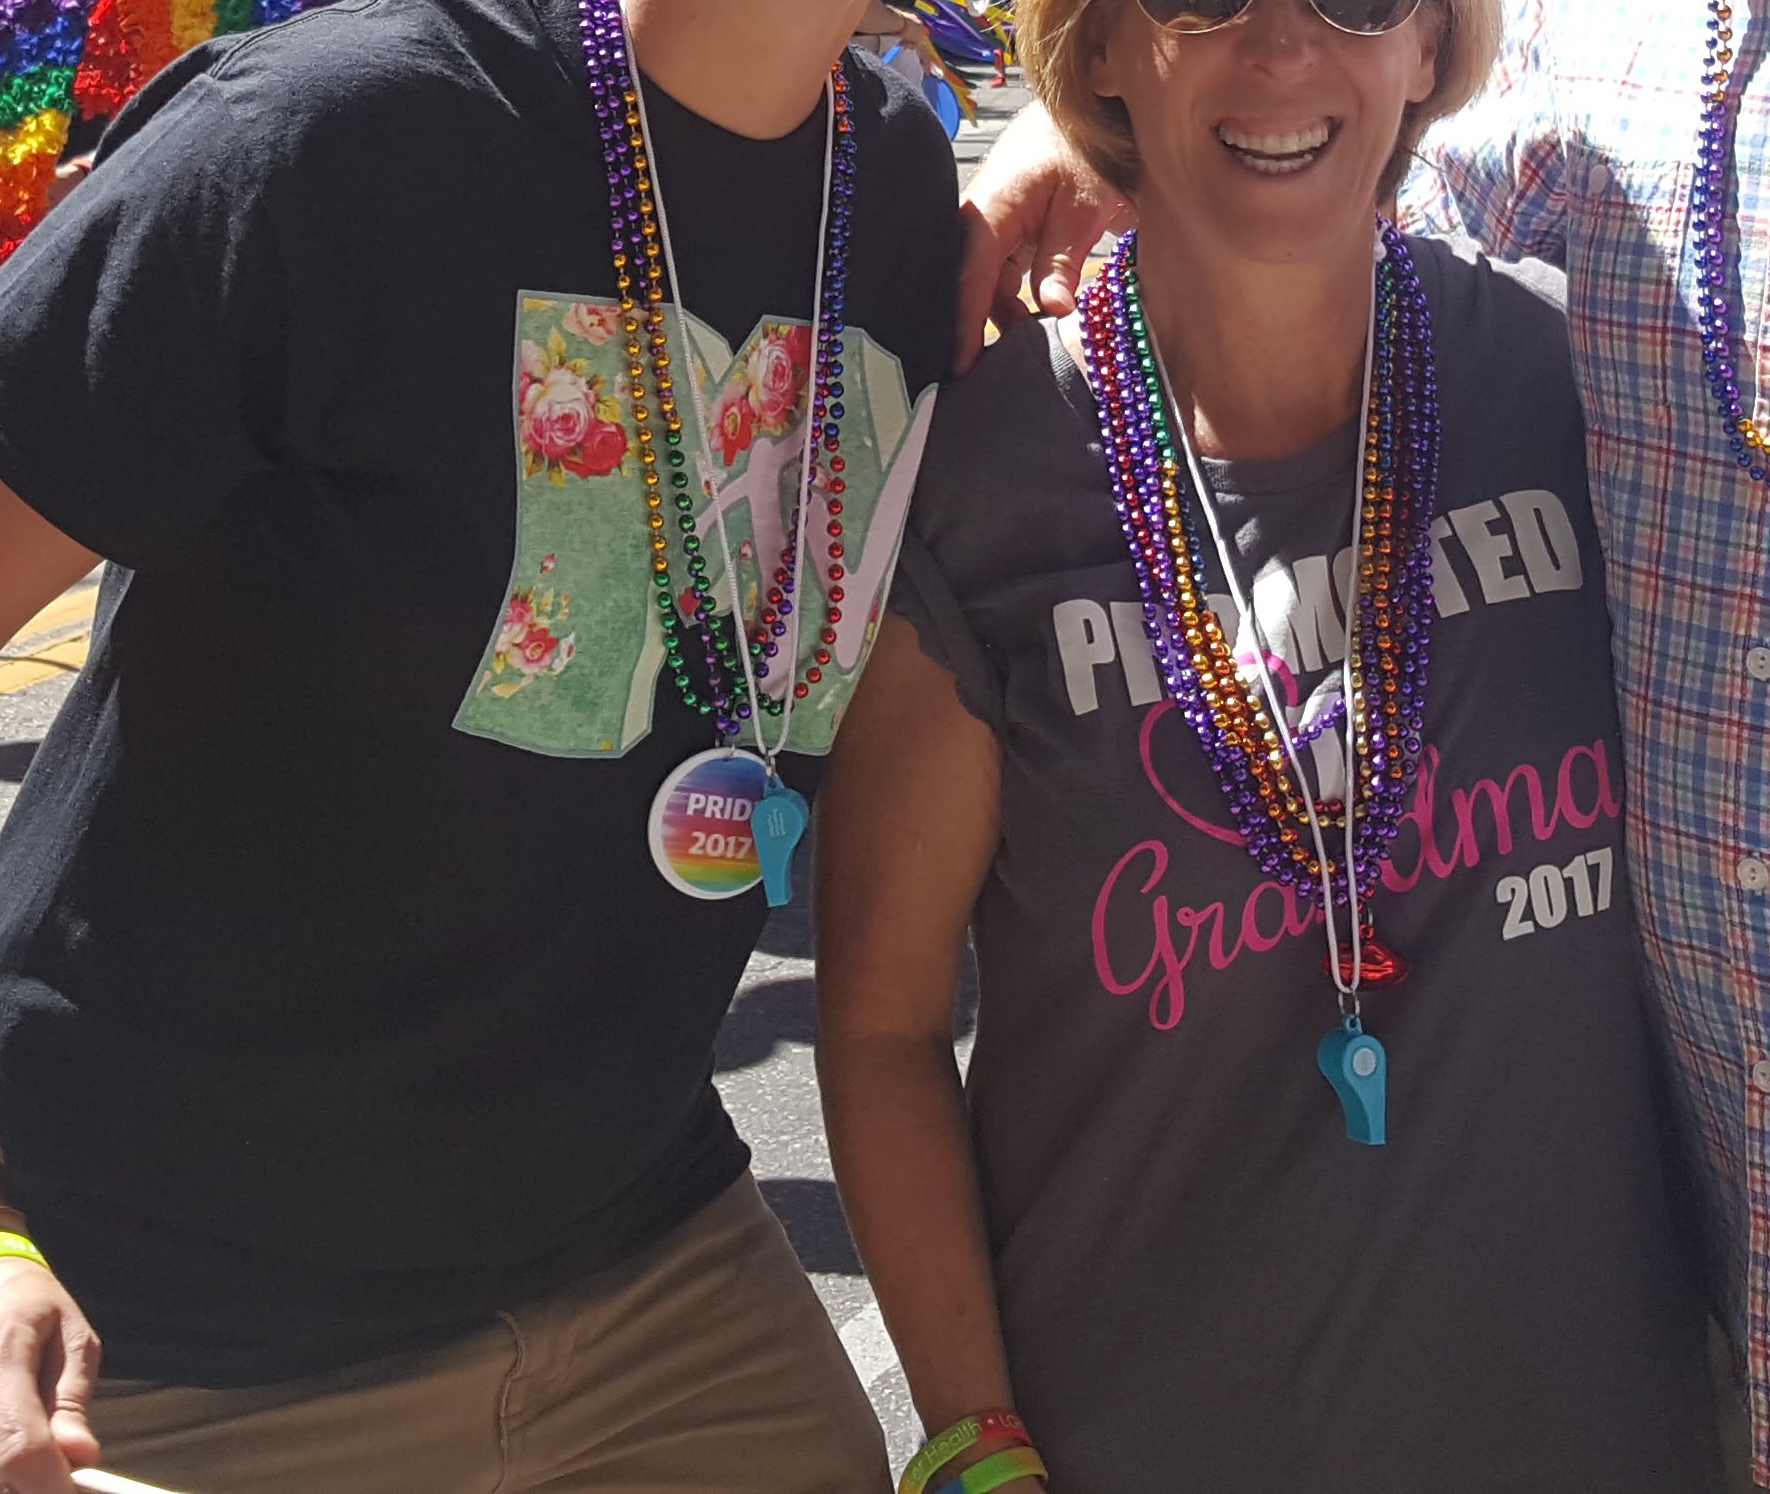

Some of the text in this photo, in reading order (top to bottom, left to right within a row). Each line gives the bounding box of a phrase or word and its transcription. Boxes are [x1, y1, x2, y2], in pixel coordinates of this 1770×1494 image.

[686, 792, 759, 822] PRID
[688, 831, 753, 860] 2017
[1092, 738, 1620, 1031] Gradma
[1496, 847, 1614, 941] 2017
[924, 1421, 983, 1463] Health
